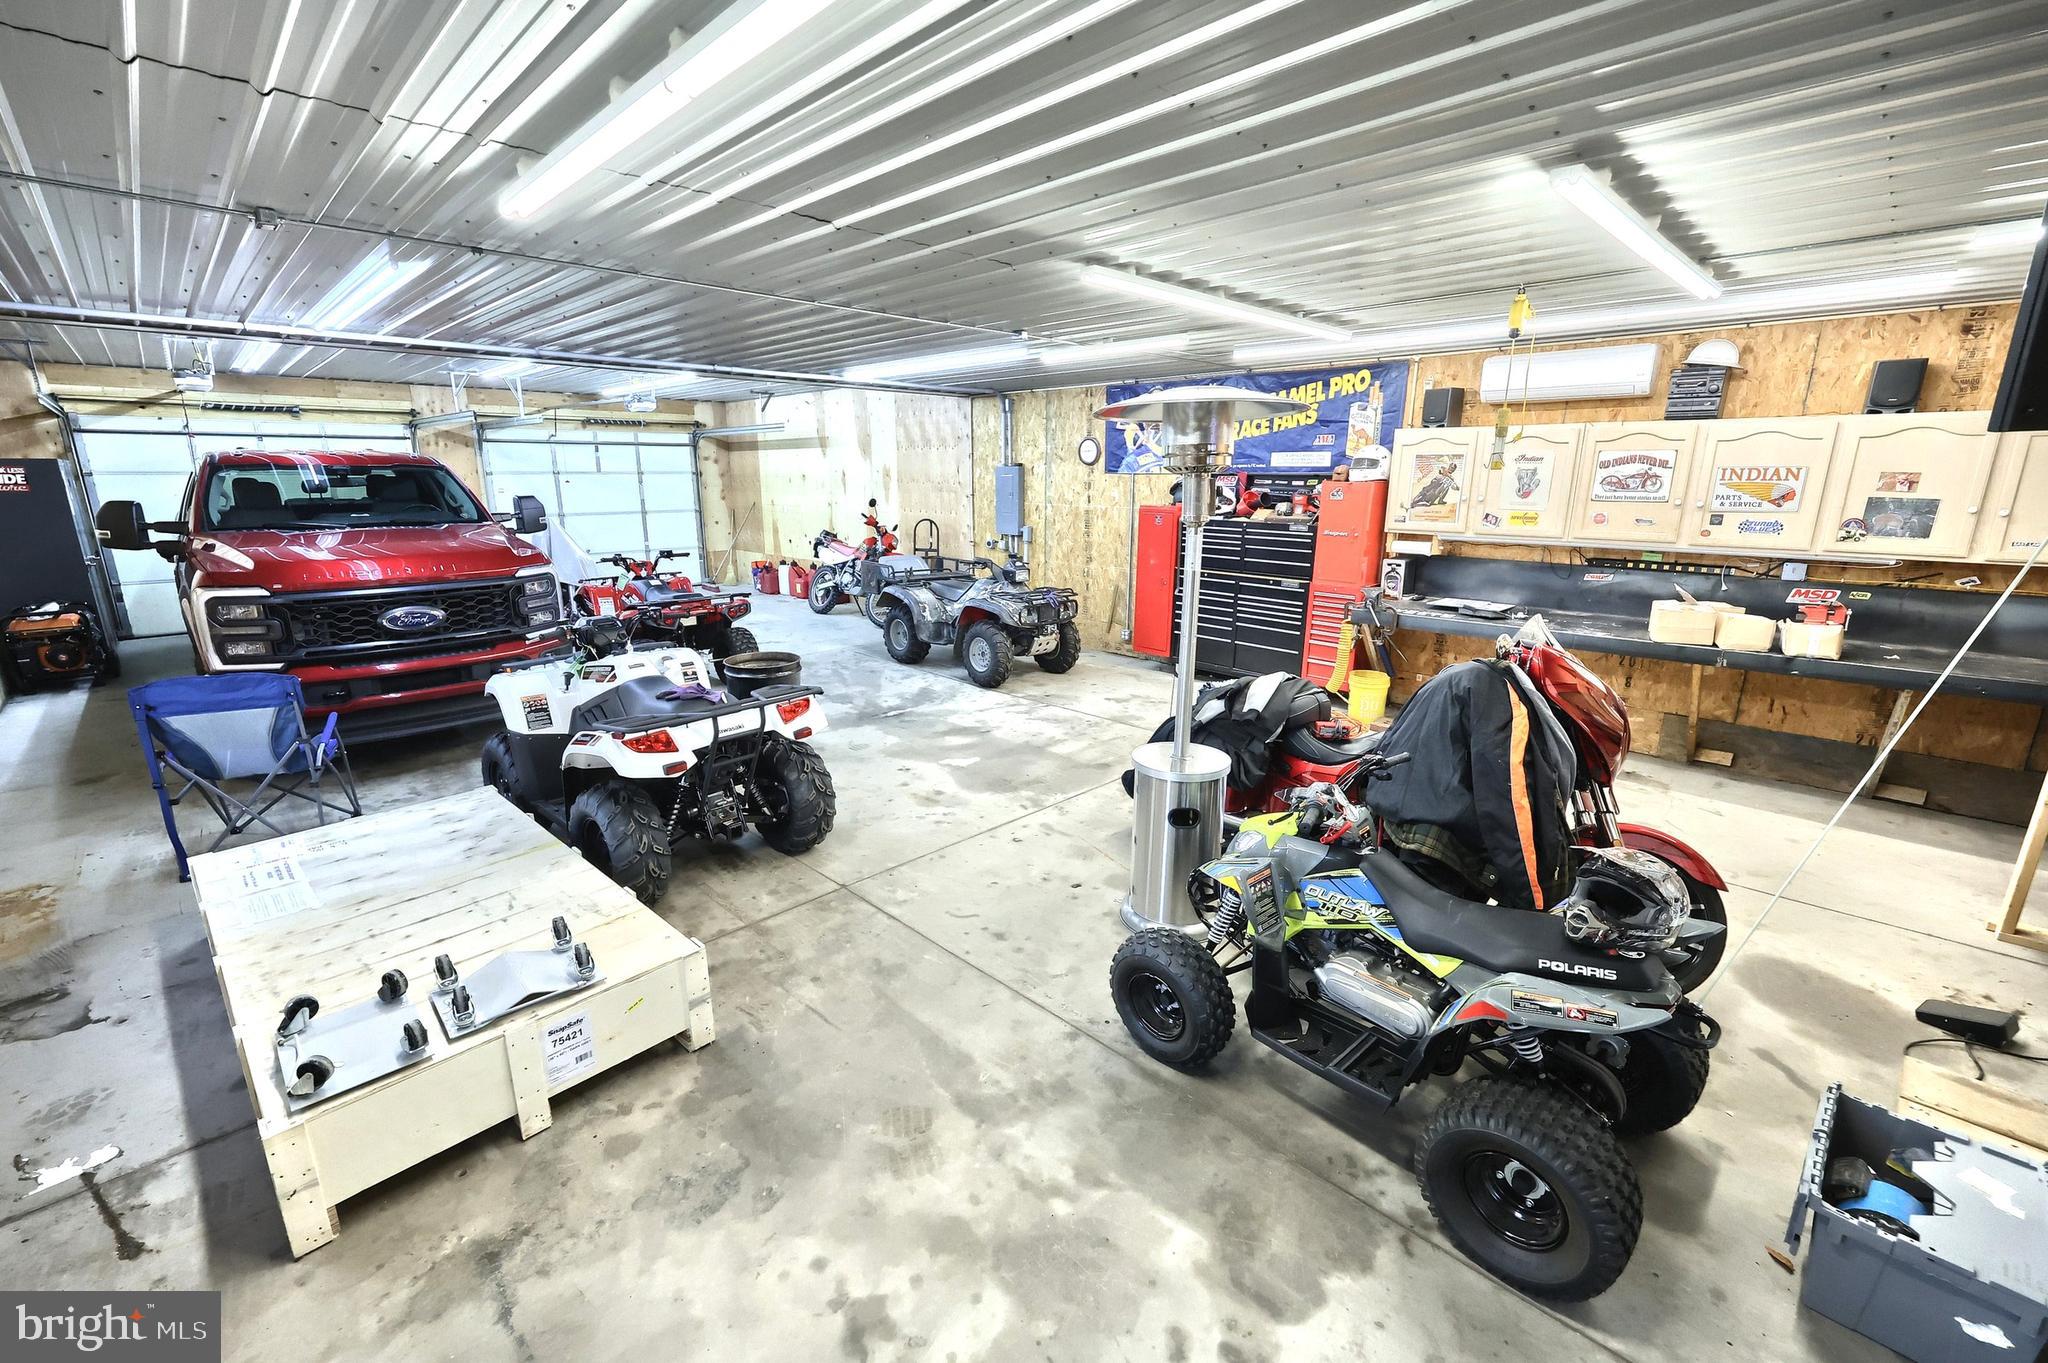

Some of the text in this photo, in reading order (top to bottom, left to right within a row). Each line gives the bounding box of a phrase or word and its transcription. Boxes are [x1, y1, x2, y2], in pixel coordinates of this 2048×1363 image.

[1328, 368, 1372, 399] PRO
[1272, 402, 1319, 433] FANS
[1514, 453, 1545, 462] Indian
[1598, 459, 1611, 469] OLD
[1611, 454, 1638, 468] INDIANS
[1638, 454, 1658, 467] NEVER
[1719, 467, 1803, 482] INDIAN
[1791, 588, 1838, 600] MSD
[397, 613, 430, 627] Ford
[1303, 883, 1391, 918] OUTLAW
[1538, 958, 1618, 981] POLARIS
[547, 1016, 585, 1037] SnapSafe
[551, 1028, 584, 1048] 75421
